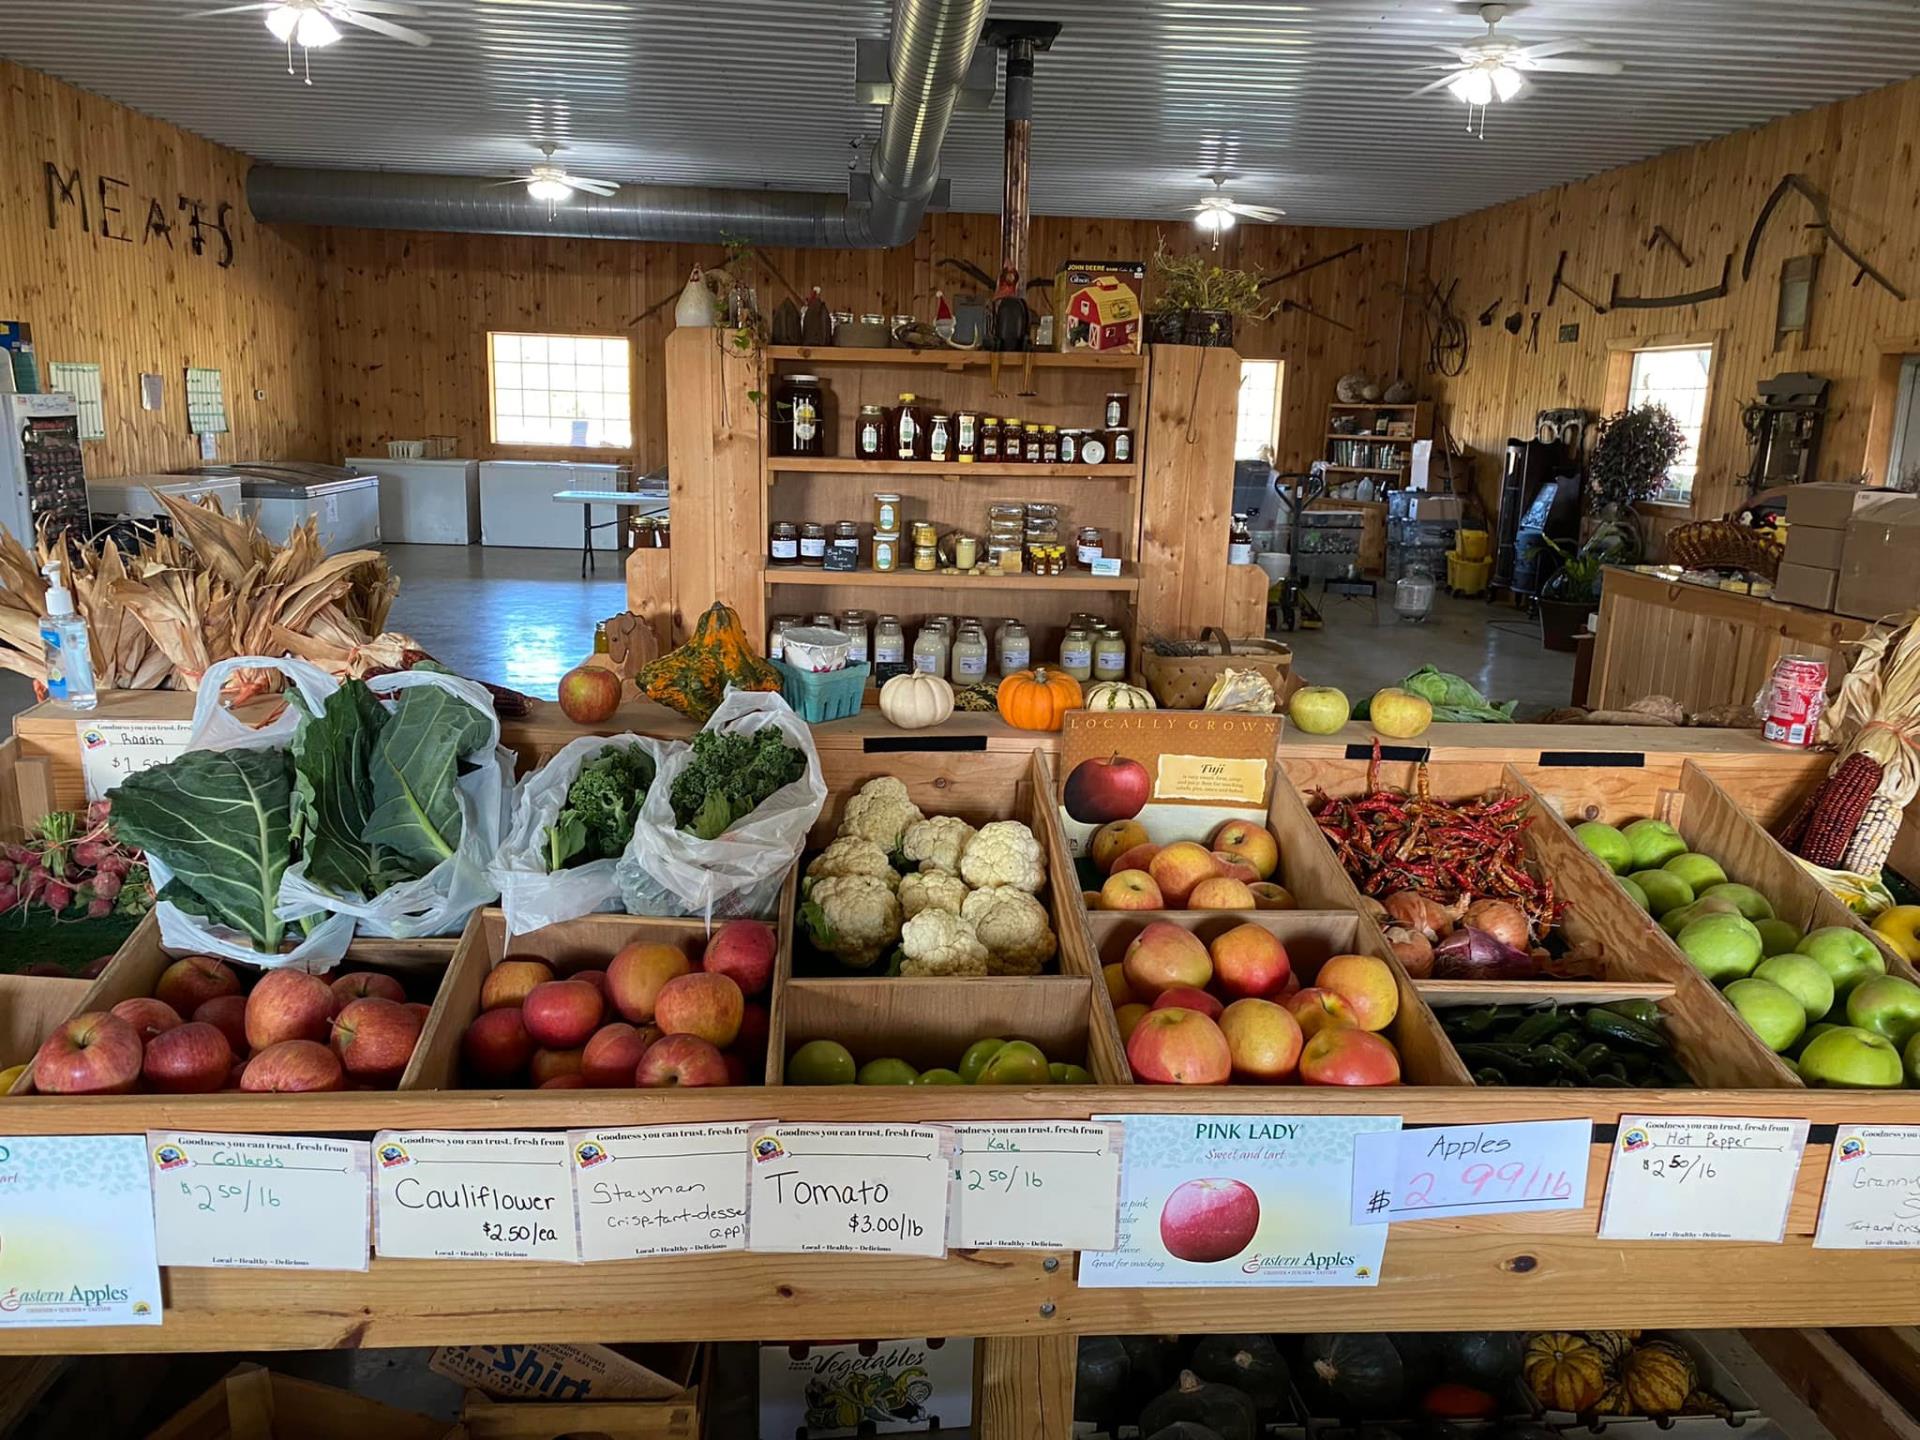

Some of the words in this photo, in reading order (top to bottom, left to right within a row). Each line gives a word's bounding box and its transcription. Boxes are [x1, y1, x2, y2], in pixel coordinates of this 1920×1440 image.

[44, 161, 233, 268] MEATS
[1071, 718, 1176, 729] LOCALLY
[1188, 719, 1276, 733] GROWN
[121, 733, 165, 745] Radish
[1201, 764, 1225, 775] Fuji
[597, 1132, 641, 1141] Goodness
[643, 1131, 660, 1140] you
[708, 1127, 733, 1136] fresh
[735, 1126, 749, 1134] fro
[776, 1128, 819, 1137] Goodness
[821, 1130, 838, 1138] you
[885, 1129, 910, 1137] fresh
[912, 1129, 934, 1139] from
[954, 1126, 991, 1134] oodness
[992, 1128, 1009, 1136] you
[1055, 1126, 1079, 1134] fresh
[1080, 1126, 1103, 1135] from
[1195, 1123, 1240, 1140] PINK
[1249, 1123, 1299, 1140] LADY
[1645, 1121, 1685, 1130] Goodness
[1686, 1123, 1702, 1132] you
[1744, 1123, 1767, 1132] fresh
[1768, 1125, 1790, 1133] from
[1862, 1130, 1901, 1138] Goodness
[1902, 1131, 1916, 1139] you
[178, 1137, 224, 1148] Goodness
[226, 1140, 245, 1150] you
[295, 1141, 322, 1152] fresh
[323, 1144, 348, 1153] from
[400, 1136, 445, 1145] Goodness
[446, 1138, 464, 1146] you
[513, 1137, 538, 1146] fresh
[540, 1138, 564, 1146] from
[986, 1137, 1020, 1151] Kale
[1427, 1132, 1511, 1160] Apples
[1666, 1132, 1692, 1146] Hot
[1706, 1133, 1752, 1149] Pepper
[212, 1151, 284, 1168] Collards
[1205, 1148, 1237, 1160] Sweet
[1240, 1149, 1260, 1160] and
[1263, 1148, 1285, 1160] tart
[395, 1178, 555, 1210] Cauliflower
[590, 1182, 706, 1204] Stayman
[765, 1171, 888, 1205] Tomato
[1128, 1198, 1149, 1212] pink
[482, 1221, 558, 1245] $2.50/ea
[709, 1225, 745, 1239] appl
[849, 1213, 923, 1240] $3.00/lb
[1873, 1221, 1894, 1232] and
[1897, 1221, 1920, 1233] cris
[1091, 1260, 1114, 1269] Great
[1116, 1259, 1129, 1270] for
[1242, 1253, 1299, 1274] Eastern
[1304, 1252, 1355, 1270] Apples
[0, 1287, 64, 1312] Eastern
[69, 1284, 128, 1306] Apples
[446, 1346, 532, 1395] CARRY-OUT
[810, 1347, 927, 1380] Vegetables
